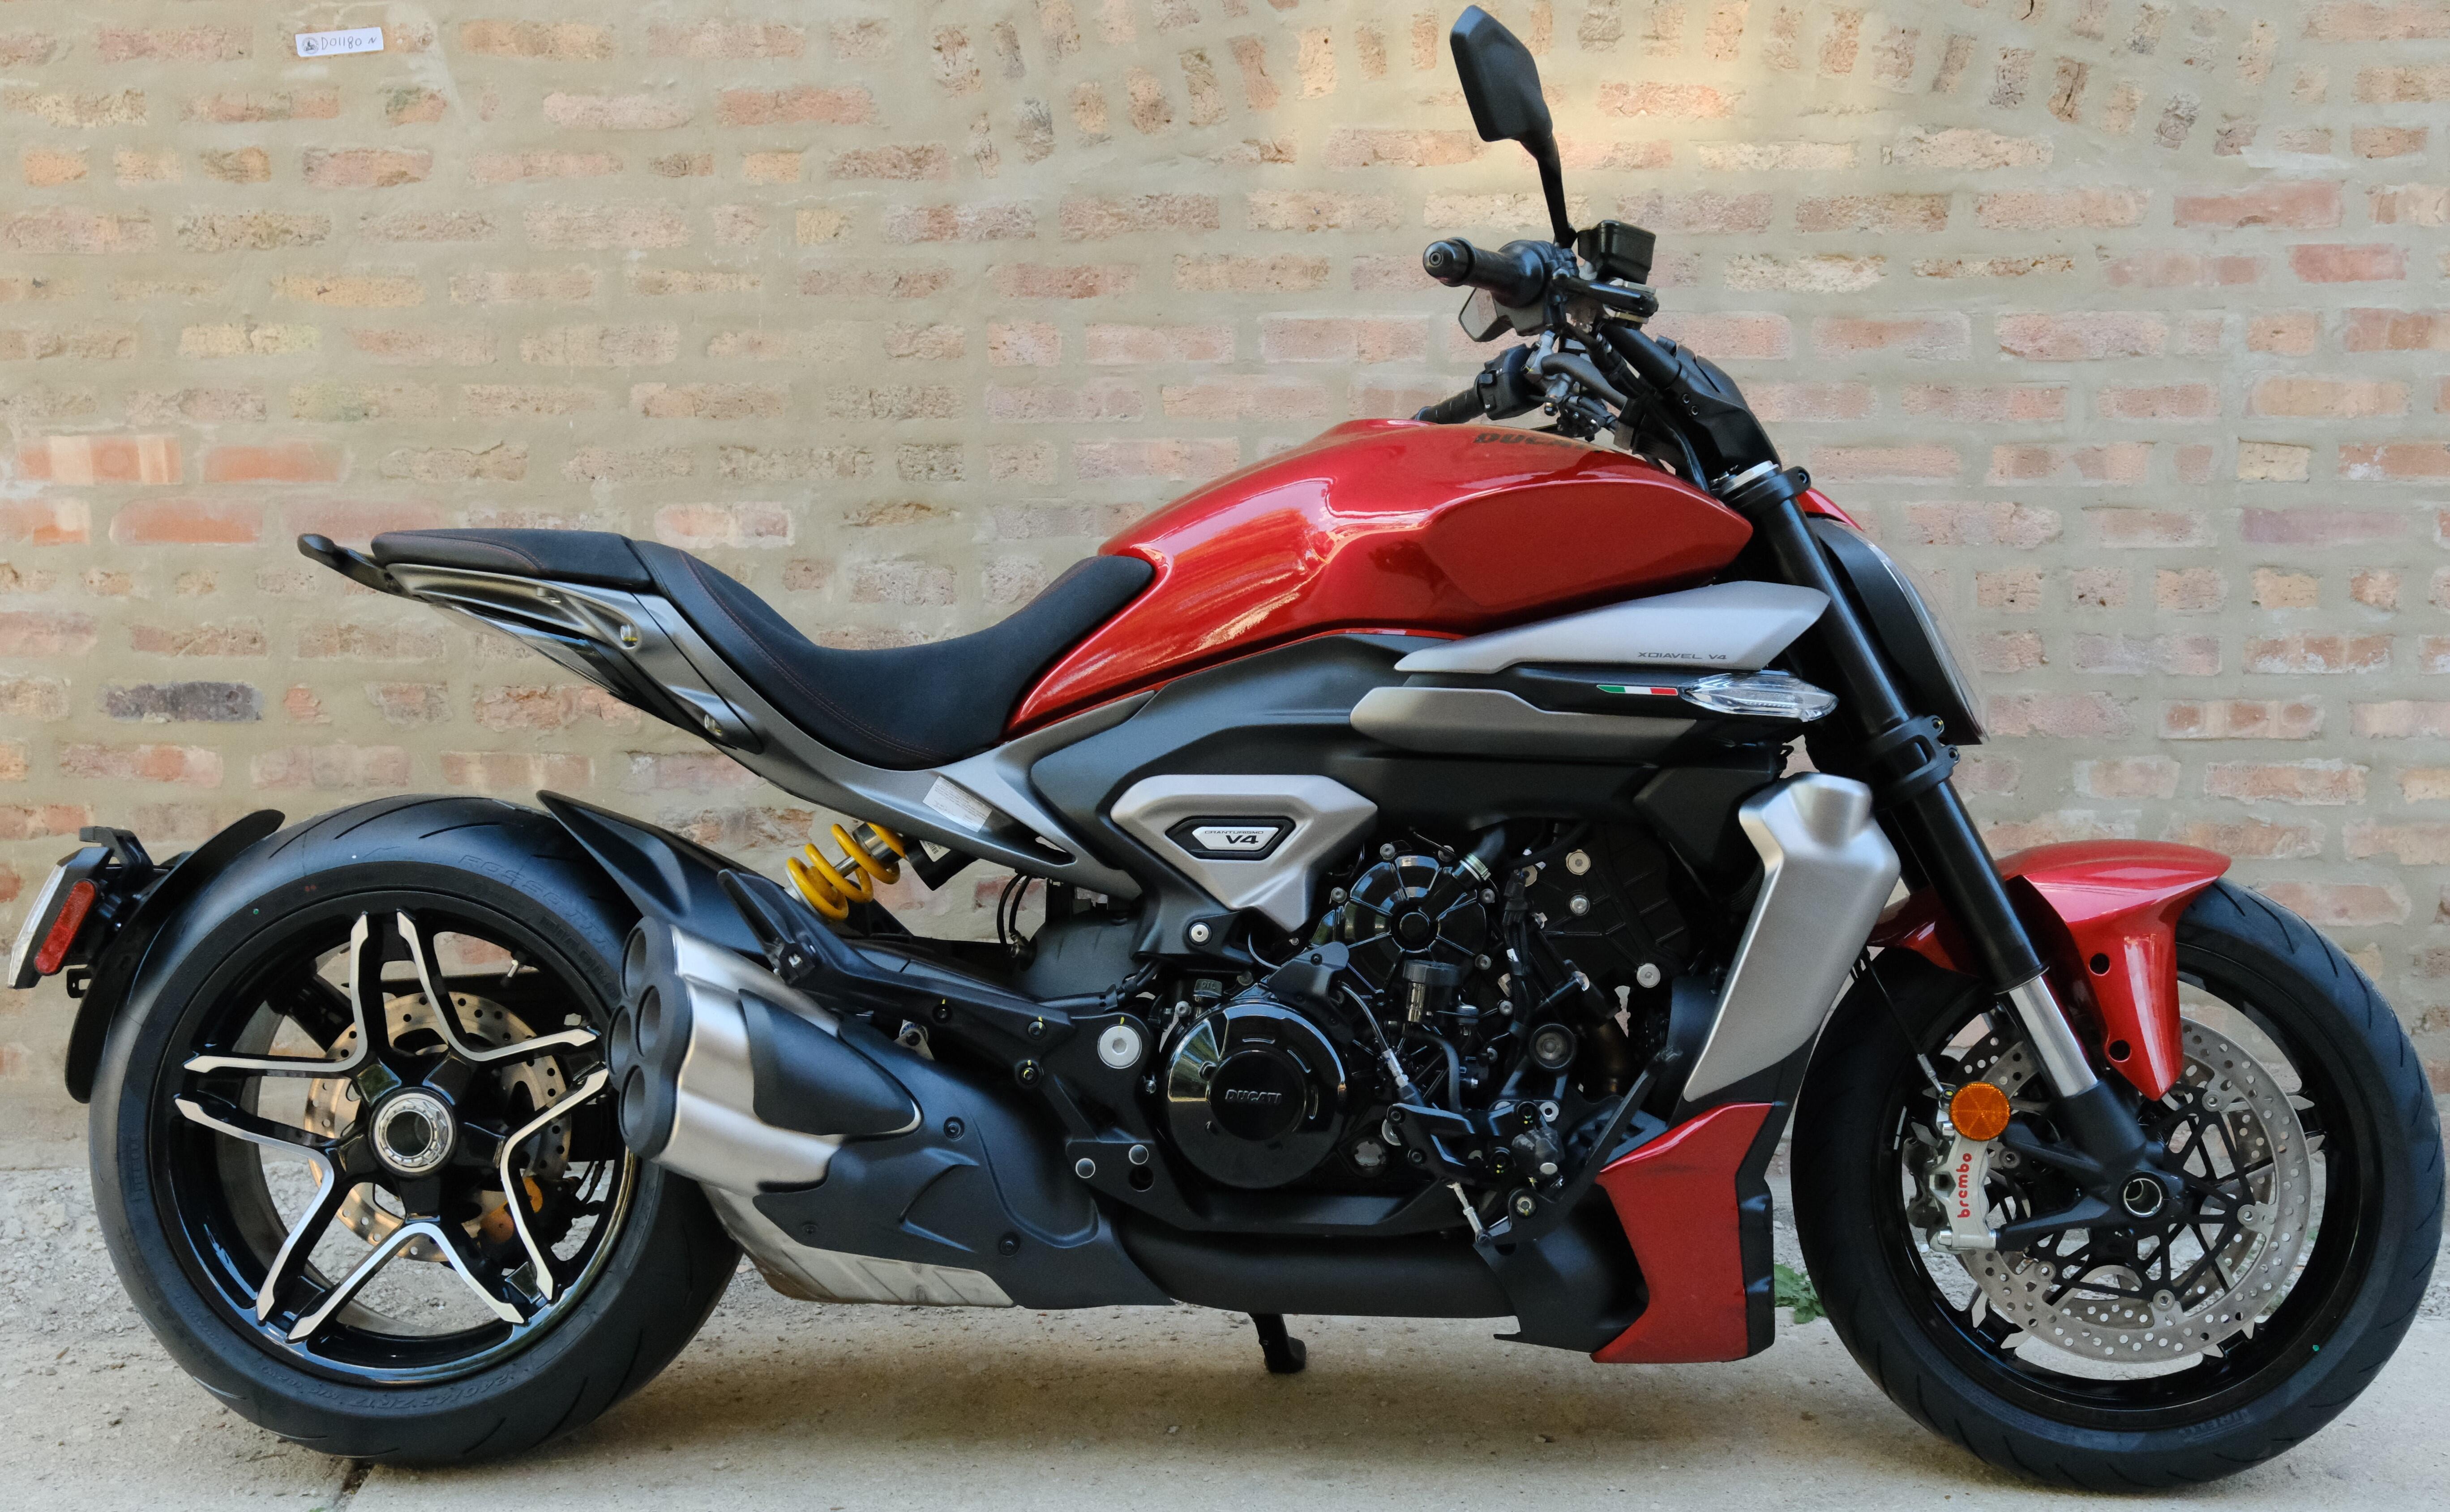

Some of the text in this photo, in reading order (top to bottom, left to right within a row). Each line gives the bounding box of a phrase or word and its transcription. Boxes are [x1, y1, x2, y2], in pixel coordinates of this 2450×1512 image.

[1225, 835, 1259, 844] V4
[1225, 1088, 1283, 1104] DUCATI
[1956, 1152, 1972, 1218] brembo
